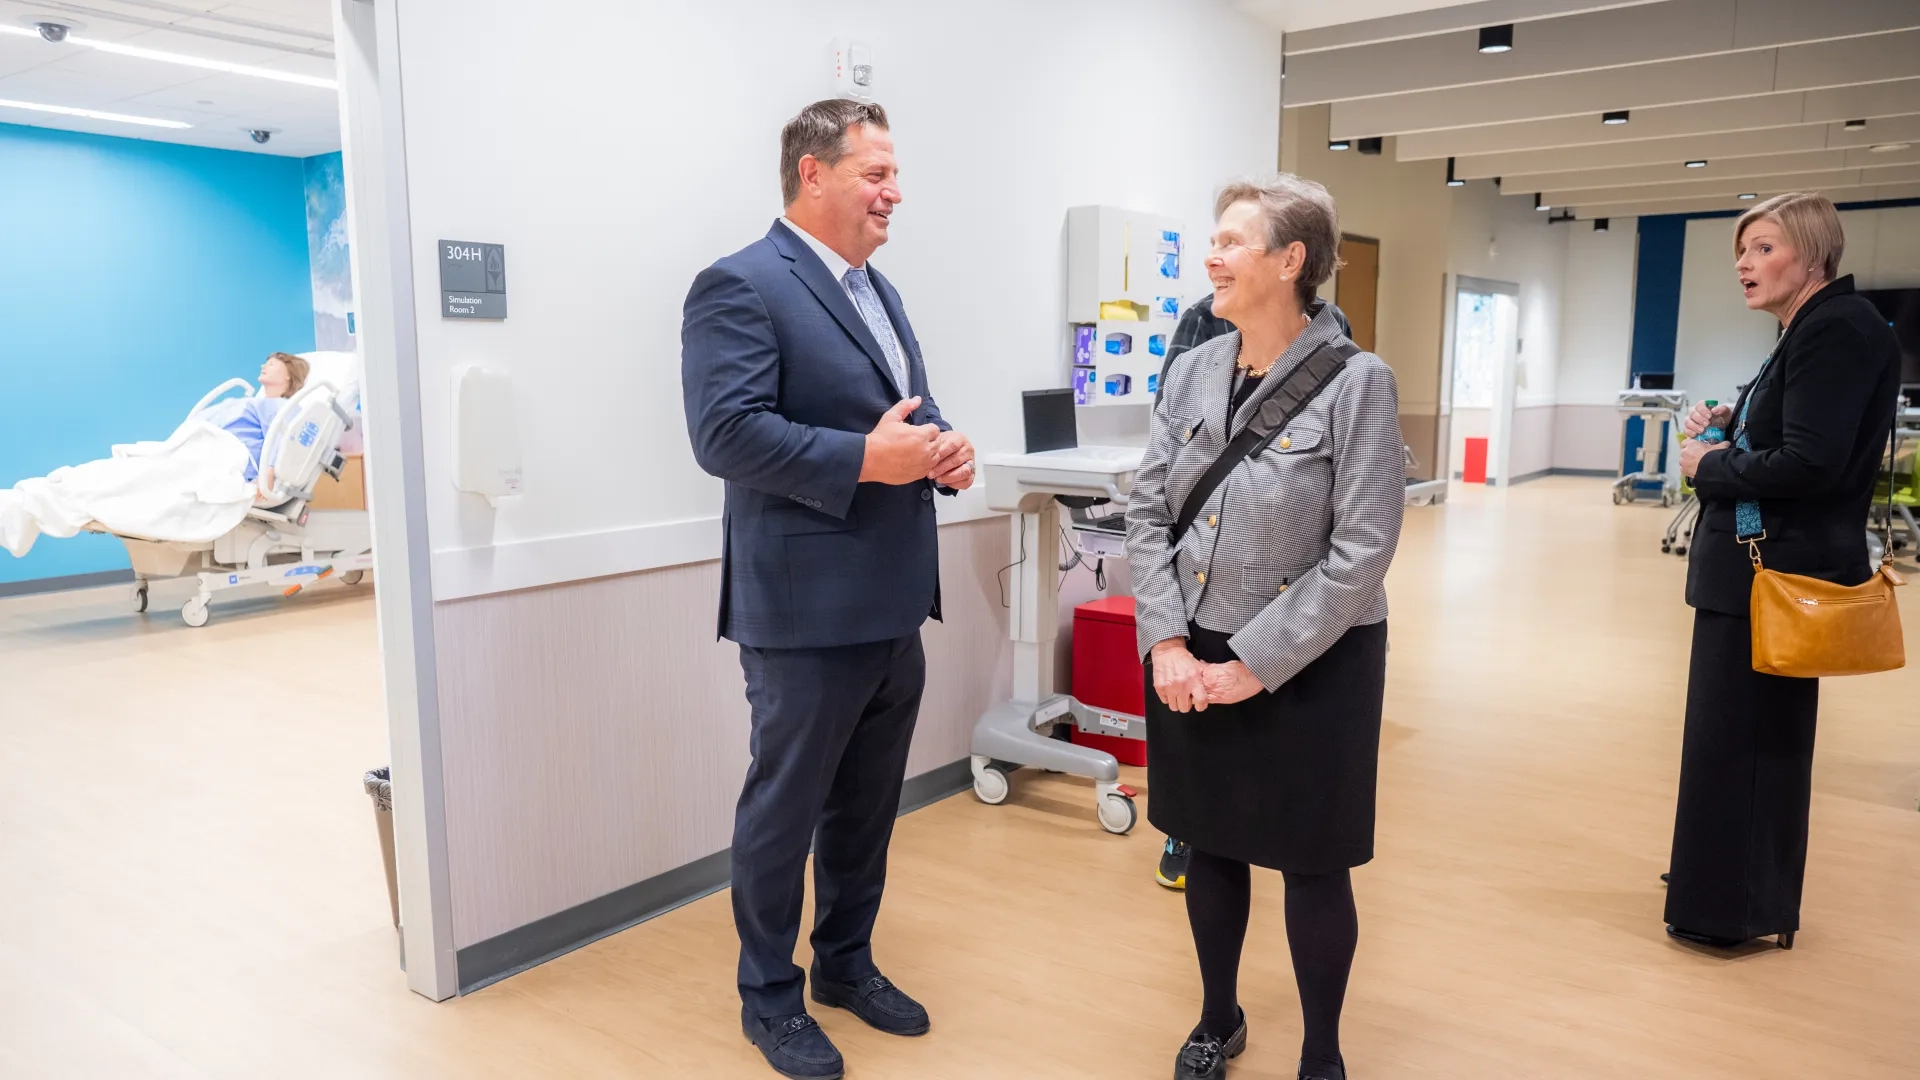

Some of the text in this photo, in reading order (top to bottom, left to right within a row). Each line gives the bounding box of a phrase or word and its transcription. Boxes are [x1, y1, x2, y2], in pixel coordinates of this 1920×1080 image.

[447, 245, 481, 261] 304H
[448, 295, 482, 304] Simulation
[449, 305, 475, 314] Room 2
